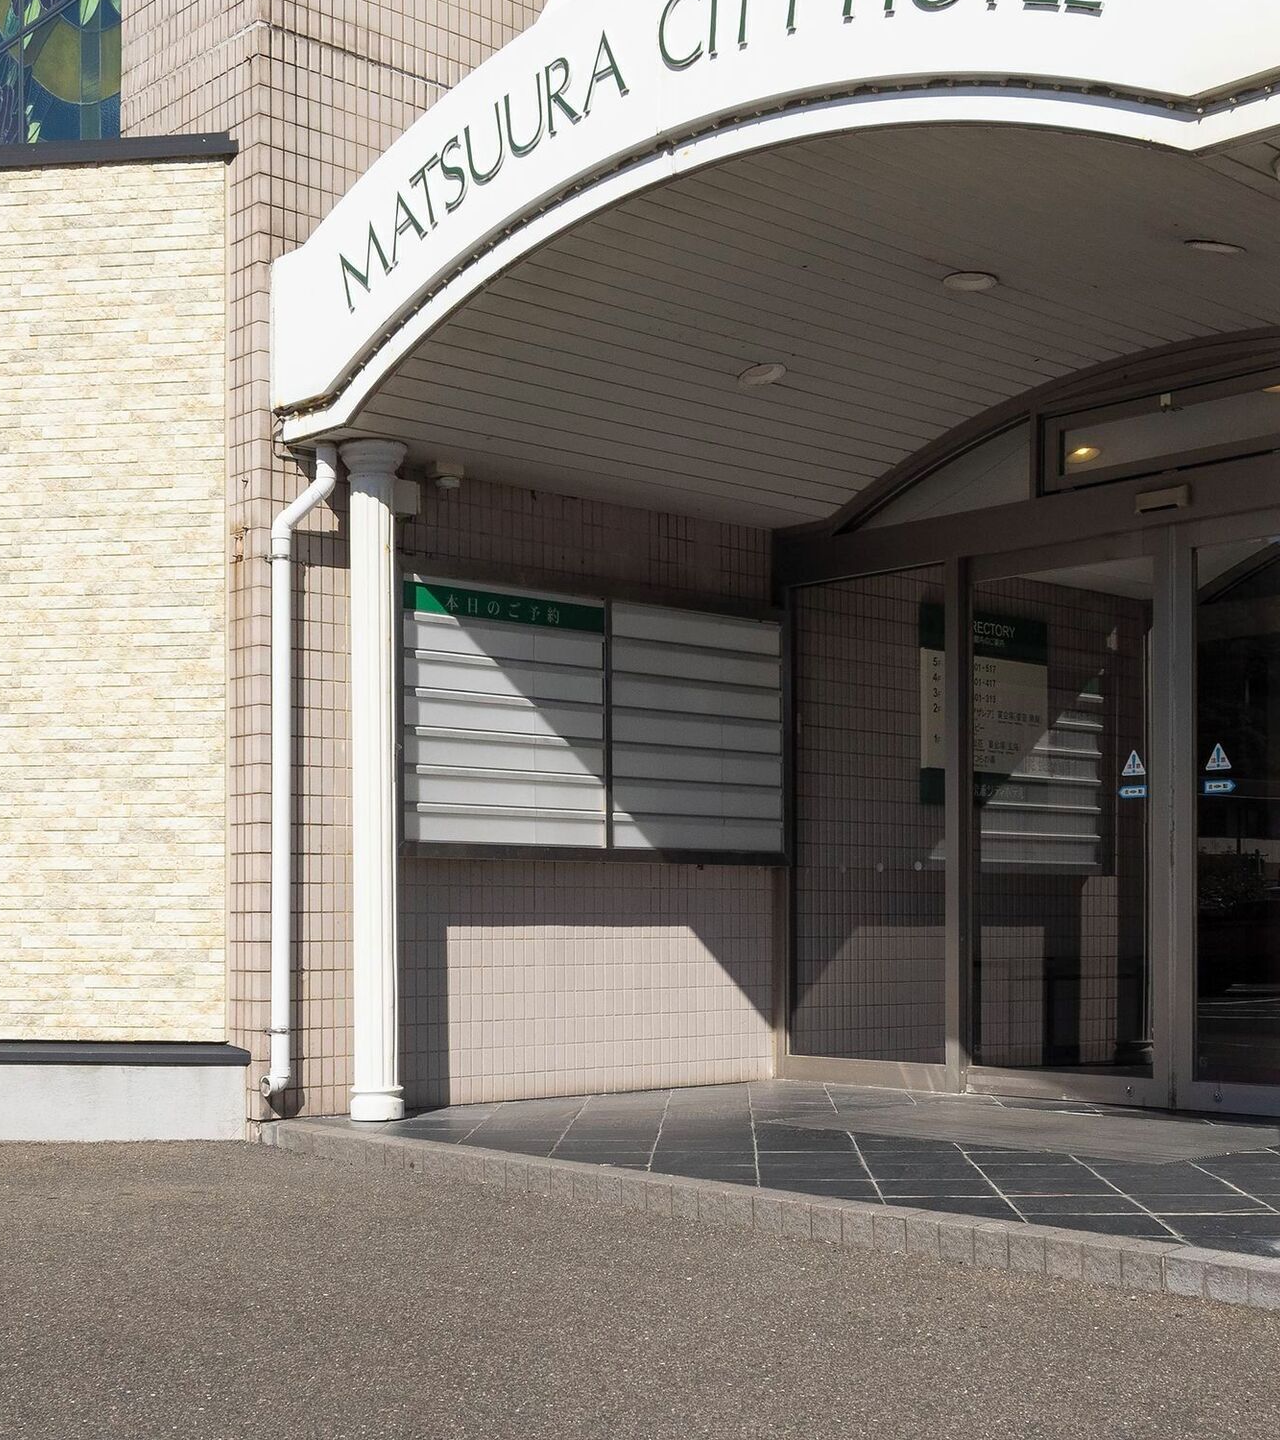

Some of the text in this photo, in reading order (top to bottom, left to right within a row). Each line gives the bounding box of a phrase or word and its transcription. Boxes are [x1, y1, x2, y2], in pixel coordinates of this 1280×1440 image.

[338, 31, 629, 314] MATSUURA
[445, 594, 560, 625] 本日のご予約
